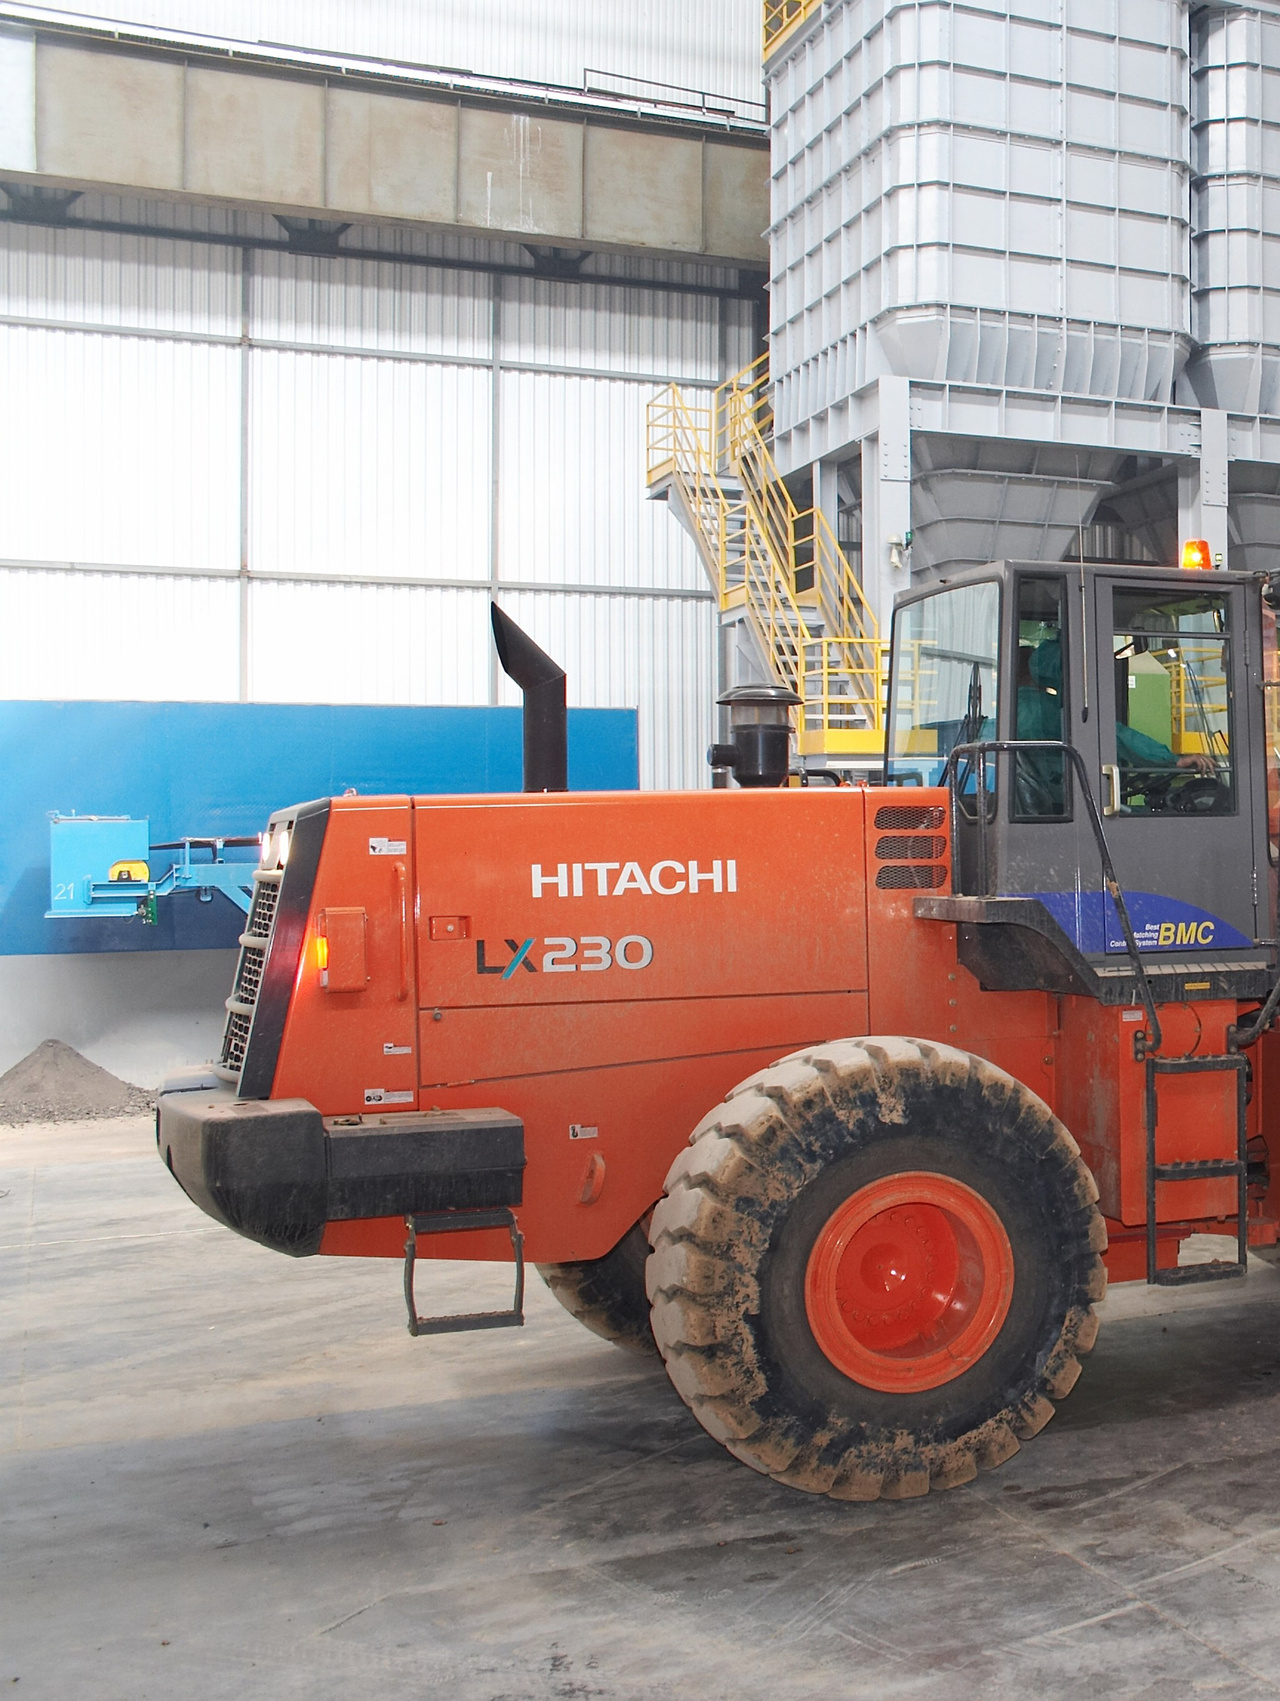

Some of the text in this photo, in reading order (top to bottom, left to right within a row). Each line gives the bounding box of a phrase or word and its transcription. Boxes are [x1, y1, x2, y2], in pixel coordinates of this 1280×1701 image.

[54, 882, 75, 900] 21
[531, 860, 737, 898] HITACHI
[1145, 923, 1160, 931] Best
[1159, 921, 1215, 946] BMC
[476, 935, 654, 980] LX230
